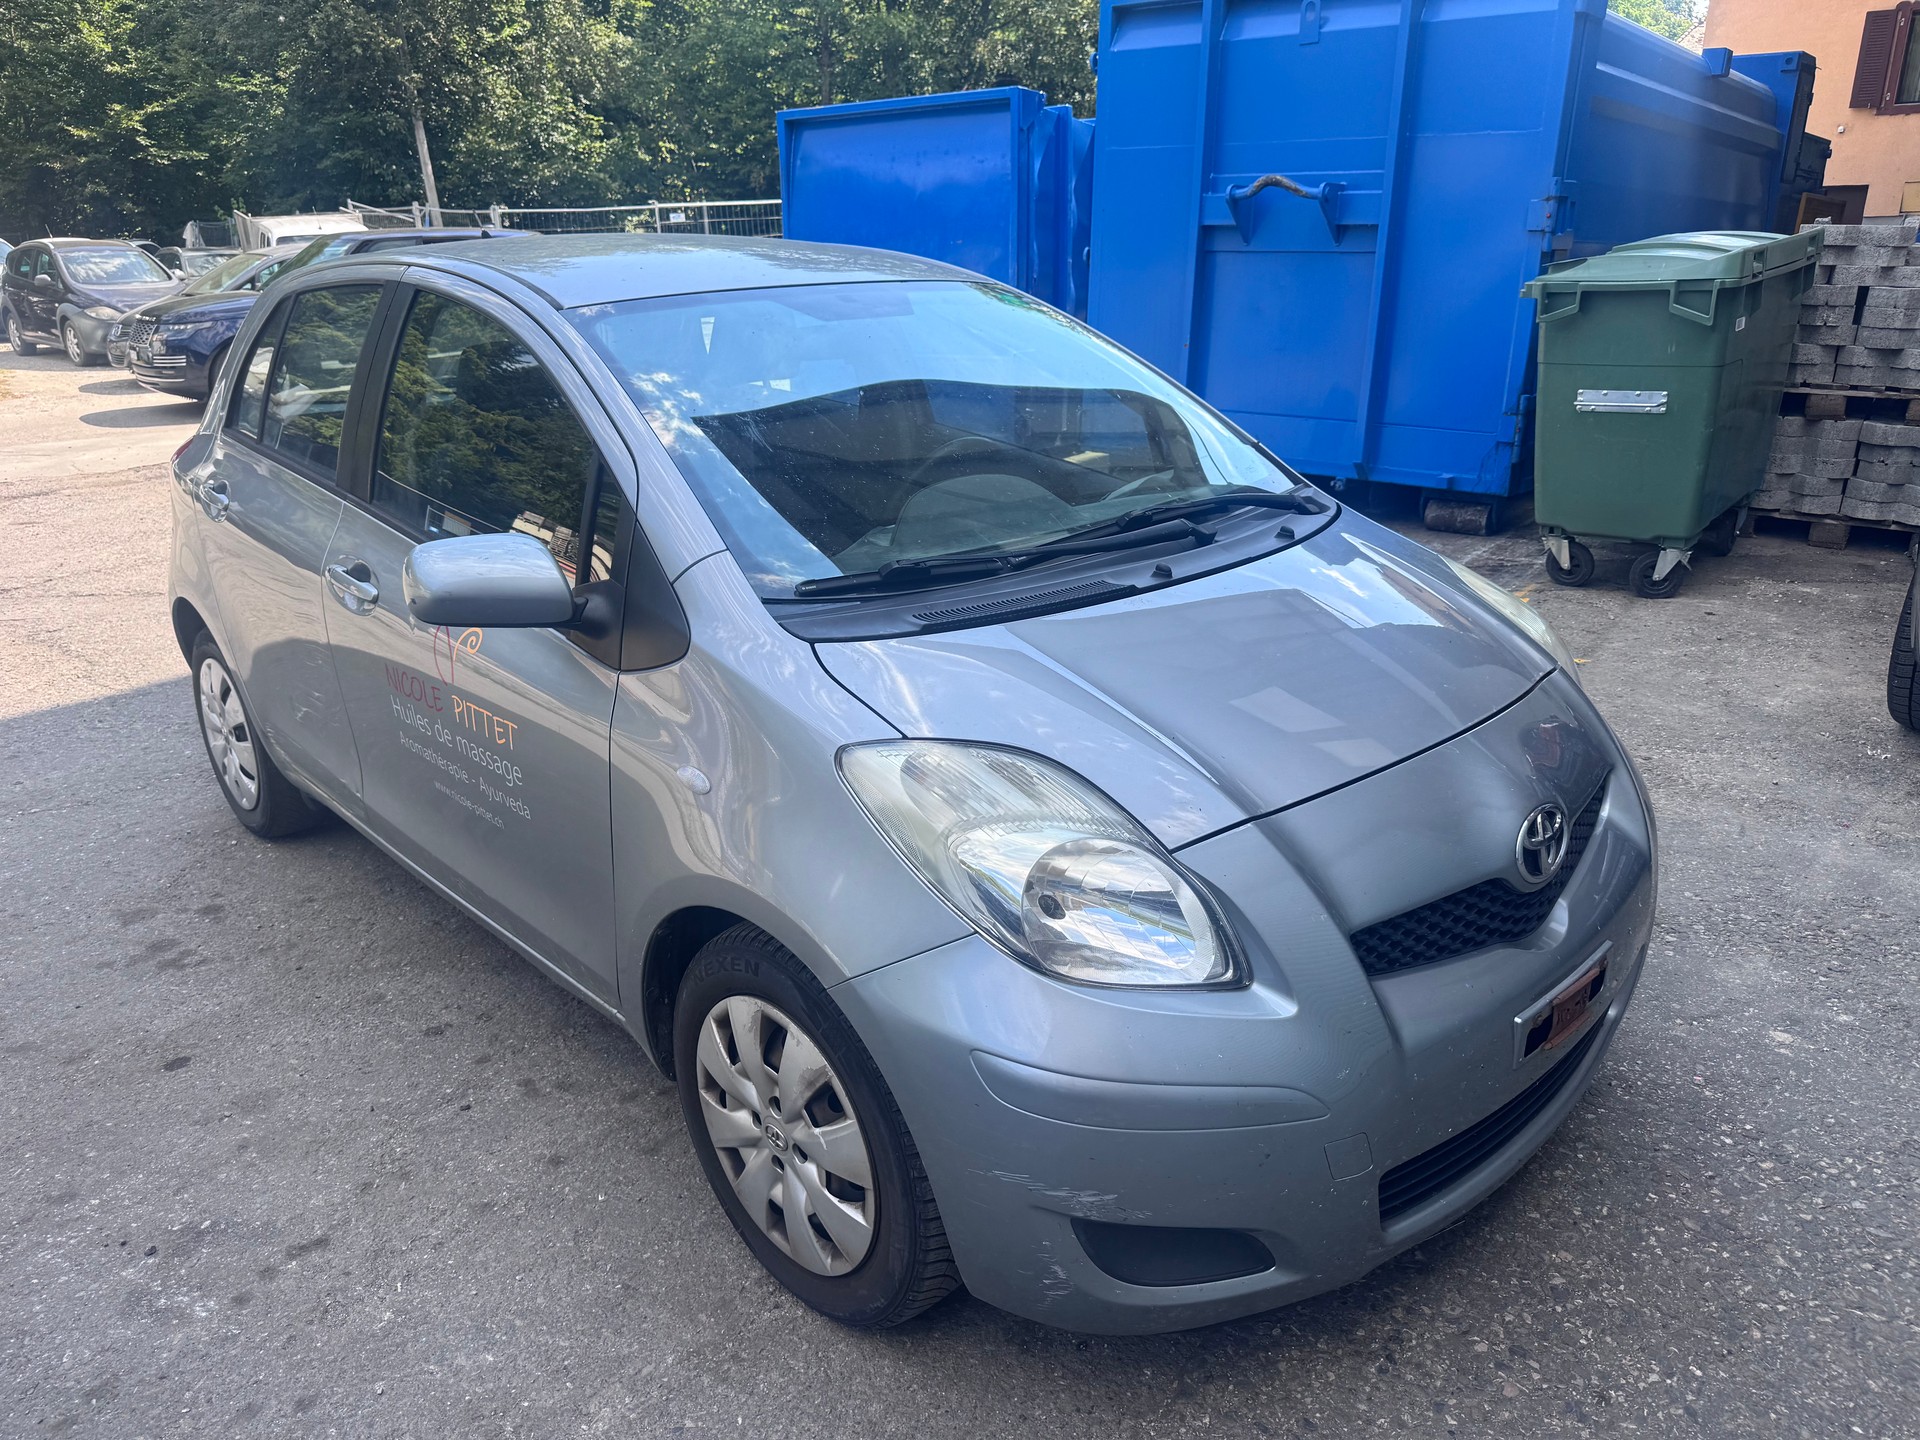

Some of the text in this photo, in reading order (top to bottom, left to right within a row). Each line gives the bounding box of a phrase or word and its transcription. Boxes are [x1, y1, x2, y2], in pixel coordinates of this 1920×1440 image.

[385, 663, 517, 750] NICOLE PITTET
[390, 694, 522, 786] Huiles de massage
[480, 776, 531, 820] Ayurveda
[693, 955, 760, 984] NEXEN
